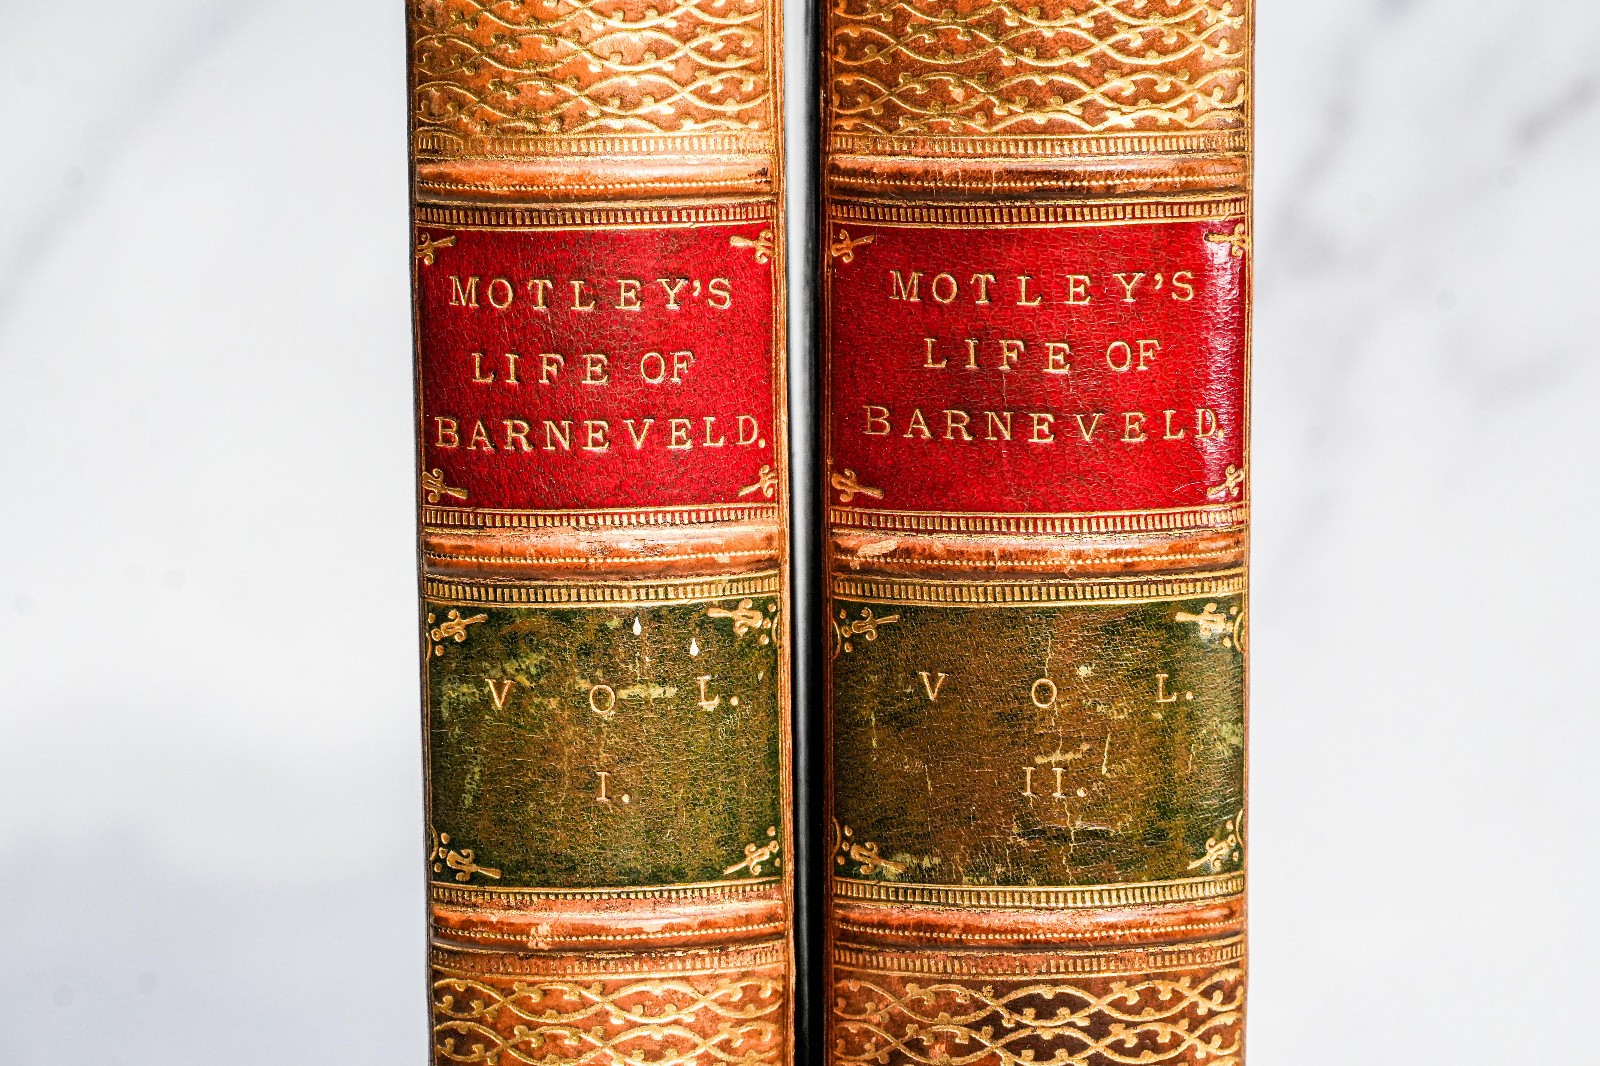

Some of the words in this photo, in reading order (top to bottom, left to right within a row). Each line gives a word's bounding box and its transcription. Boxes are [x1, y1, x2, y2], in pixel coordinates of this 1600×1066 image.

[449, 275, 732, 311] MOTLEY'S
[889, 269, 1195, 306] MOTLEY'S
[471, 352, 609, 385] LIFE
[640, 351, 695, 384] OF
[923, 337, 1071, 374] LIFE
[1106, 339, 1162, 371] OF
[434, 415, 766, 452] BARNEVELD.
[862, 405, 1224, 443] BARNEVELD.
[485, 675, 739, 714] VOL.
[919, 671, 1195, 708] VOL.
[596, 771, 630, 802] I.
[1022, 766, 1087, 799] II.
